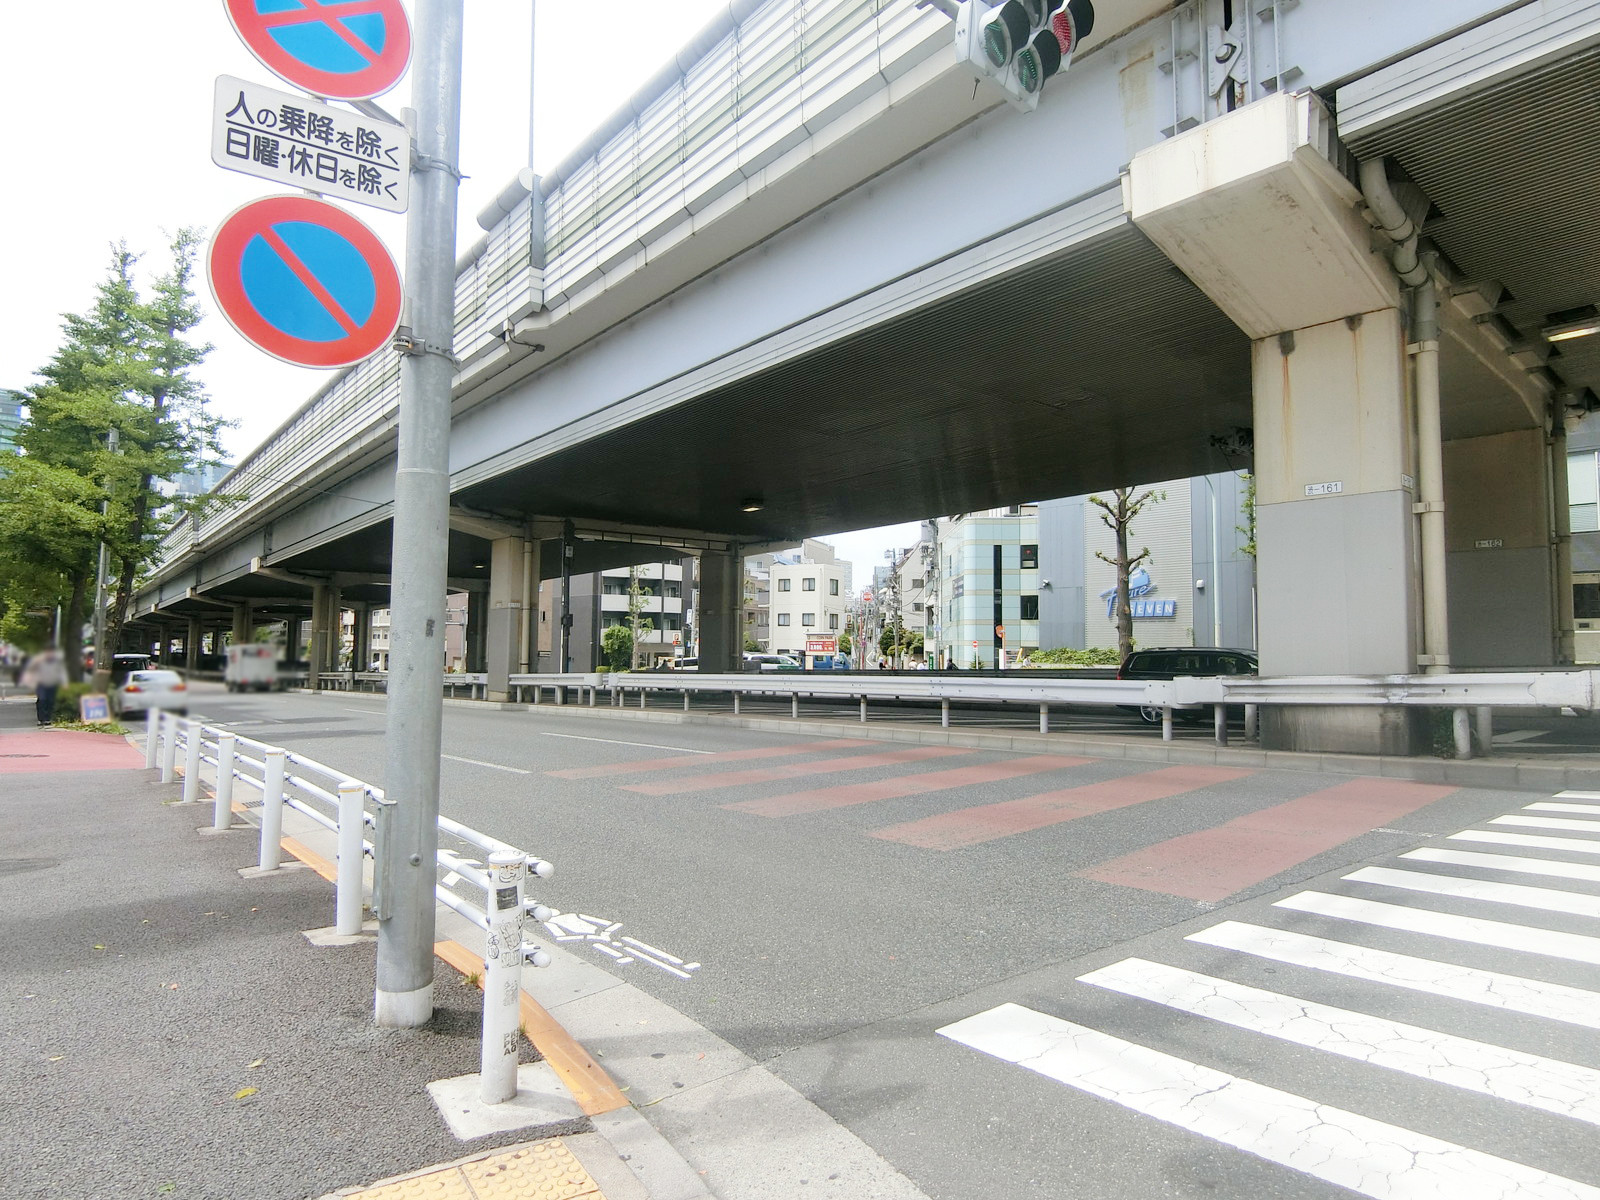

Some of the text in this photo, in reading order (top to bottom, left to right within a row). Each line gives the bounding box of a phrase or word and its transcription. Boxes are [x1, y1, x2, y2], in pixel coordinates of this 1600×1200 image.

[225, 90, 399, 166] 人の乗降を除く
[225, 127, 398, 201] 日曜・休日を除く
[1130, 603, 1173, 615] SEVEN
